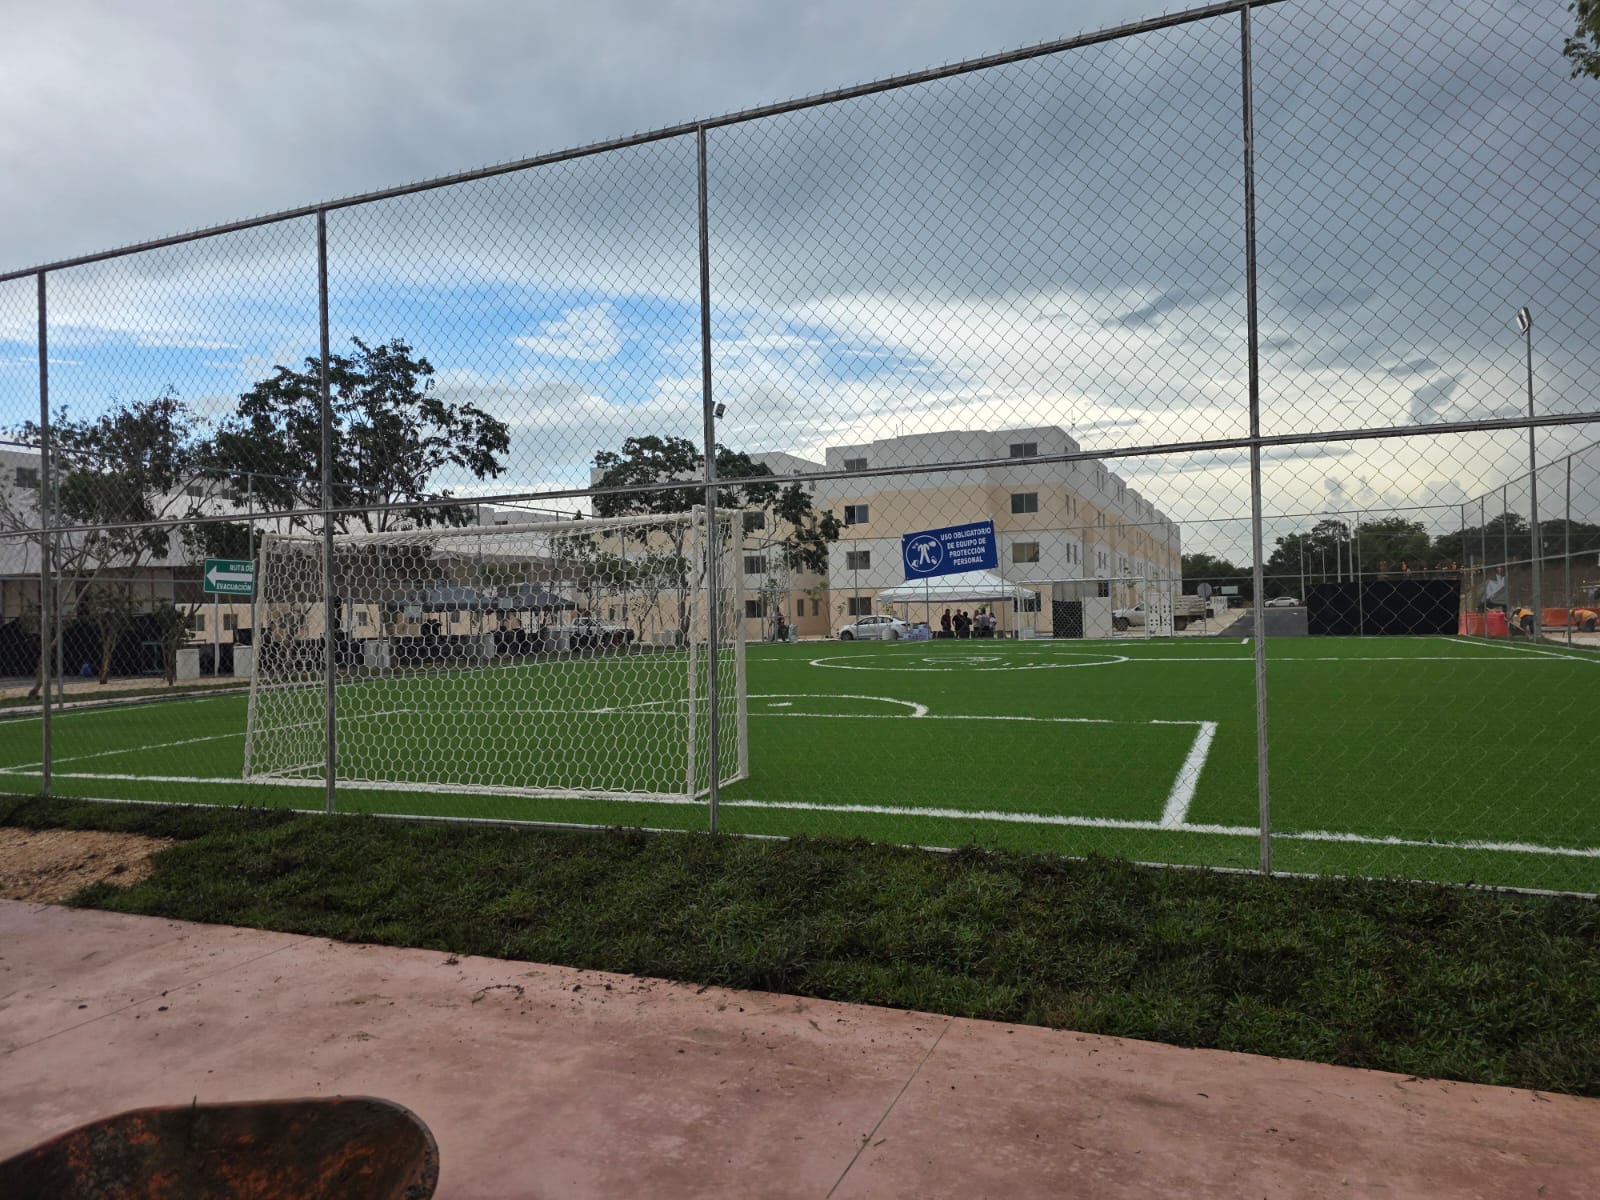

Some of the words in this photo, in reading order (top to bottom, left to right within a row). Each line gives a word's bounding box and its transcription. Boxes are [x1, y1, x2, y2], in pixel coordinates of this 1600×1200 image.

[940, 533, 952, 541] USO
[953, 527, 991, 539] OBLIGATORIO
[956, 538, 977, 547] EQUIPO
[953, 555, 983, 566] PERSONAL
[216, 582, 251, 590] EVACUACIÓN
